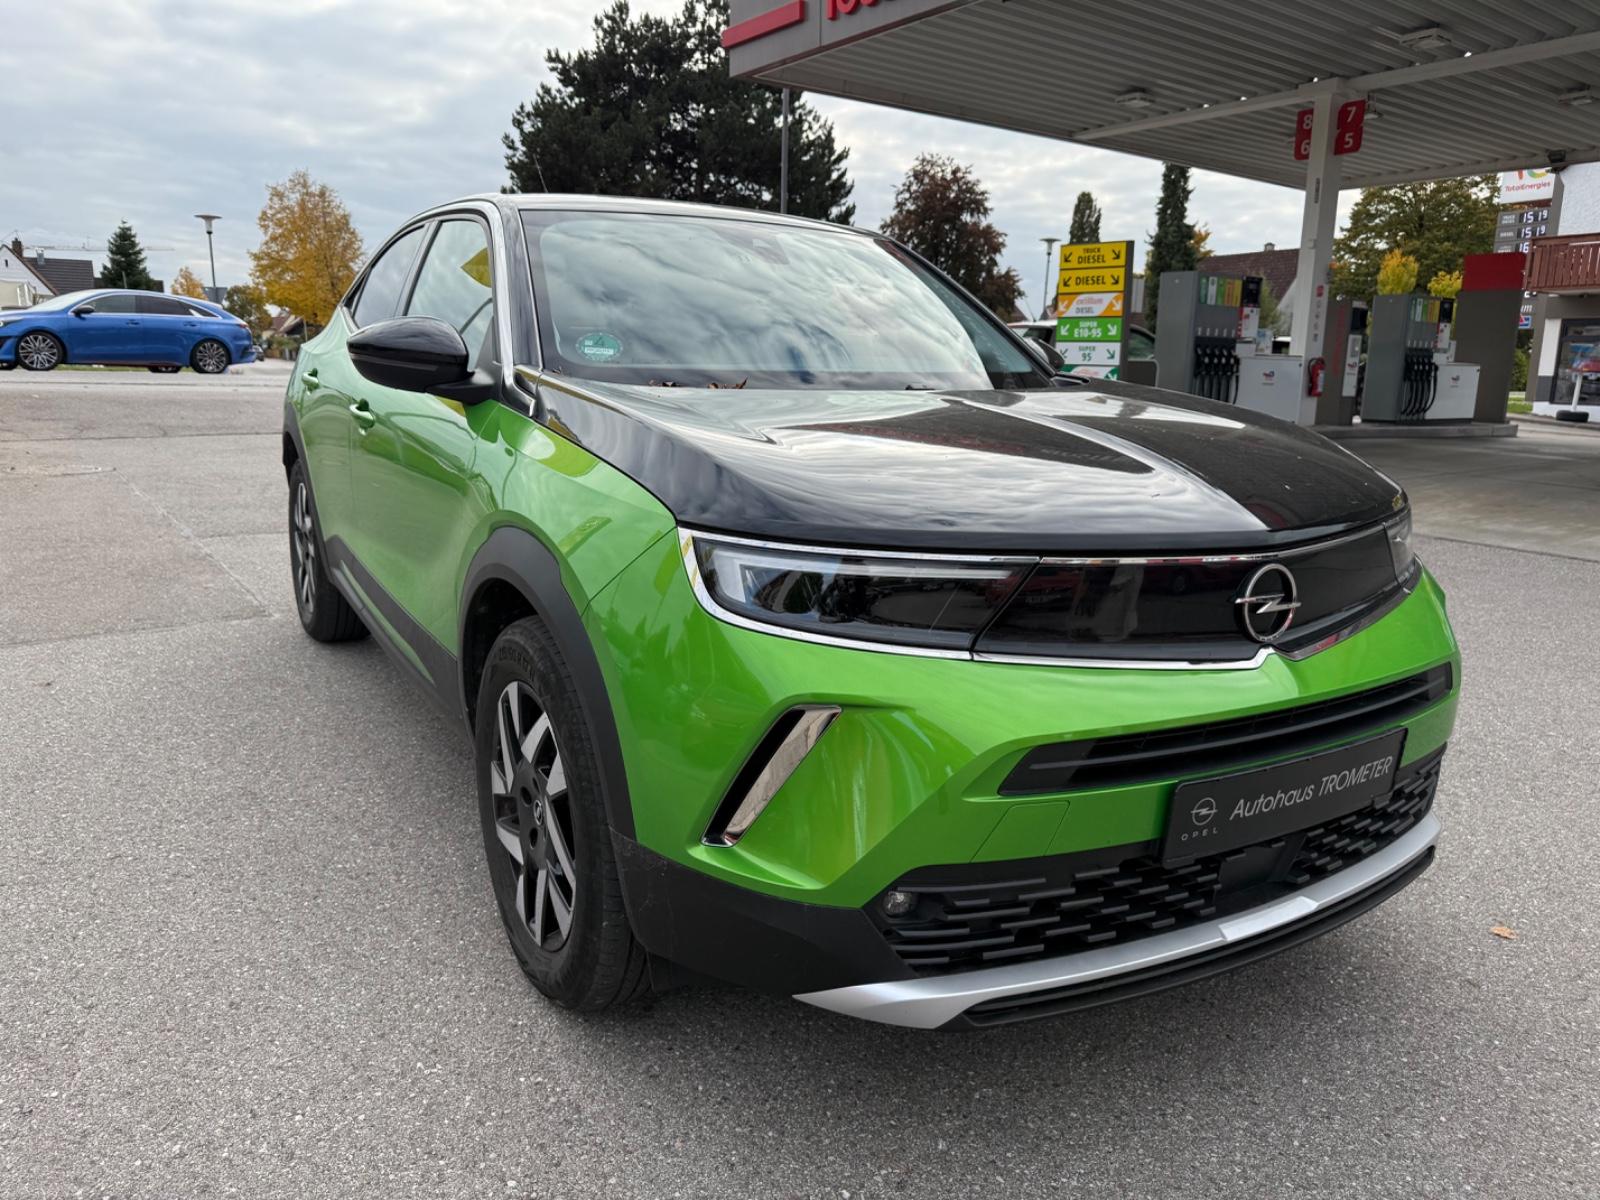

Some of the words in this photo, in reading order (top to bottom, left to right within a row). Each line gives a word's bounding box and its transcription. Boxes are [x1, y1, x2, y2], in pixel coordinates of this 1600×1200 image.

[1346, 106, 1356, 123] 7
[1303, 114, 1313, 130] 8
[1300, 140, 1310, 155] 6
[1343, 133, 1354, 148] 5
[1505, 181, 1551, 192] TotalEnergies
[1077, 254, 1106, 264] DIESEL
[1075, 275, 1106, 286] DIESEL
[1074, 328, 1102, 338] E10-95
[1082, 352, 1092, 362] 95
[1229, 784, 1315, 821] Autohaus
[1318, 756, 1393, 797] TROMETER
[1181, 827, 1219, 841] OPEL
